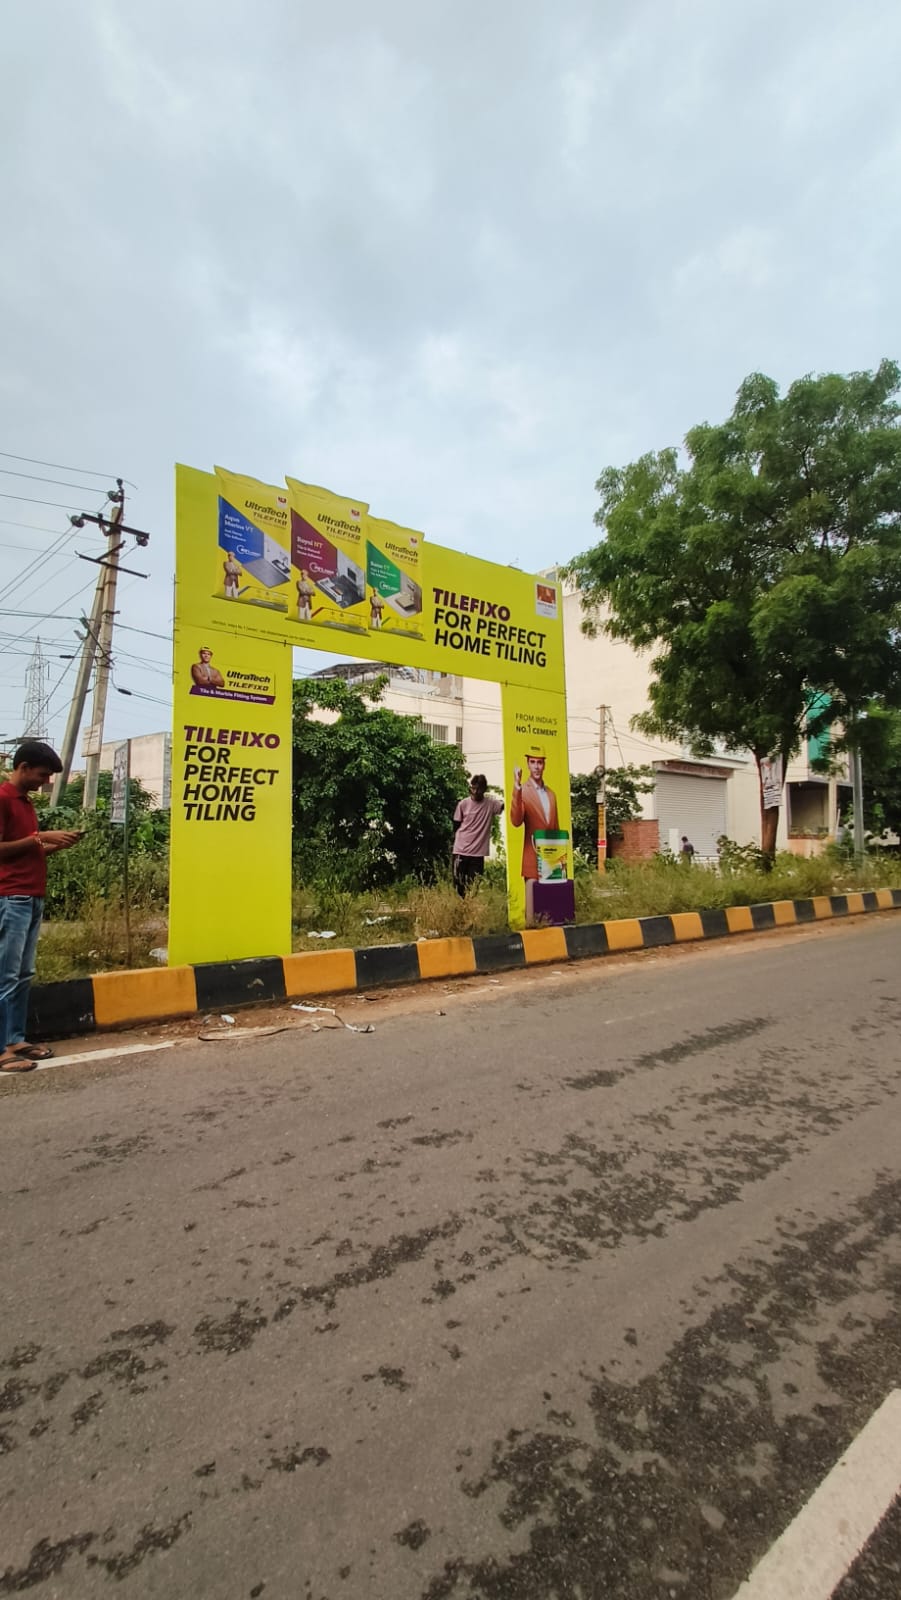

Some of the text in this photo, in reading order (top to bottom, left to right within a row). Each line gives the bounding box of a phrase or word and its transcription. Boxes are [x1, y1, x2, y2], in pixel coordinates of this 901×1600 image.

[245, 500, 288, 519] UltraTech
[317, 513, 361, 533] UltraTech
[385, 542, 418, 557] UltraTech
[432, 587, 510, 621] TILEFIXO
[433, 608, 546, 648] FOR PERFECT
[434, 628, 547, 668] HOME TILING
[226, 670, 271, 683] UltraTech
[228, 681, 269, 691] TILEFIXO
[515, 713, 558, 725] FROM INDIA'S
[183, 725, 280, 749] TILEFIXO
[516, 724, 558, 737] NO.1 CEMENT
[183, 745, 231, 764] FOR
[183, 764, 279, 785] PERFECT
[182, 783, 255, 803] HOME
[183, 803, 256, 822] TILING
